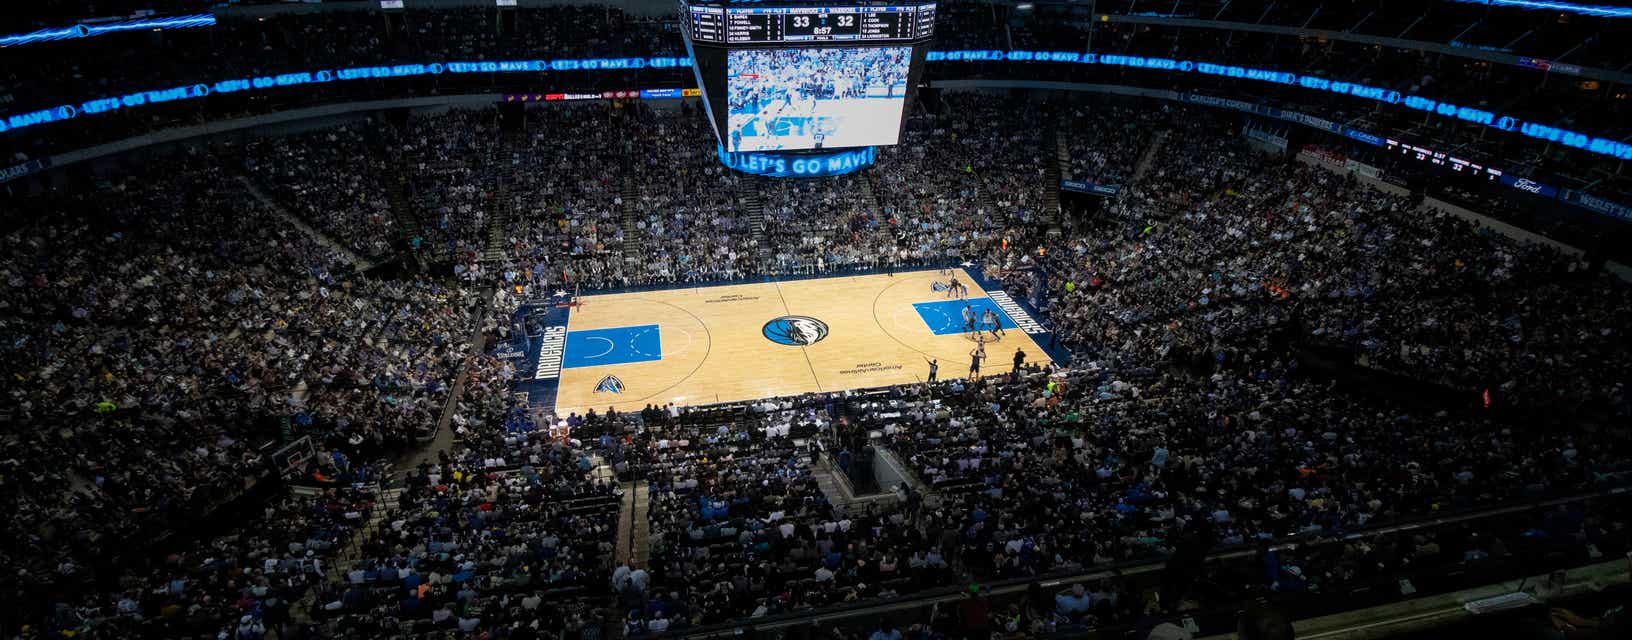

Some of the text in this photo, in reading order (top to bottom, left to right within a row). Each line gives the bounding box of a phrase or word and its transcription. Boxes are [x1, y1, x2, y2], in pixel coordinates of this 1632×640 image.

[793, 16, 810, 27] 33
[837, 15, 854, 27] 32
[650, 58, 693, 67] LET'S GO
[926, 51, 988, 61] ET'S GO MAVS
[1008, 51, 1079, 62] LET'S GO MAVS
[1100, 55, 1176, 69] LET'S GO MAVS
[372, 66, 391, 77] GO
[393, 64, 425, 76] MAVS
[449, 61, 528, 72] LET'S GO MAVS
[552, 59, 628, 70] LET'S GO MAVS
[253, 77, 273, 88] GO
[277, 73, 311, 86] MAVS
[1227, 66, 1244, 78] GO
[1247, 69, 1278, 82] MAVS
[1331, 81, 1349, 93] GO
[1351, 83, 1384, 98] MAVS
[1437, 102, 1456, 116] GO
[1562, 131, 1588, 148] GO
[741, 151, 868, 174] LET'S GO MAVS
[1064, 181, 1086, 189] GEICO
[1514, 178, 1542, 194] Ford
[987, 290, 1047, 335] MAVERICKS
[535, 325, 566, 380] MAVERICKS
